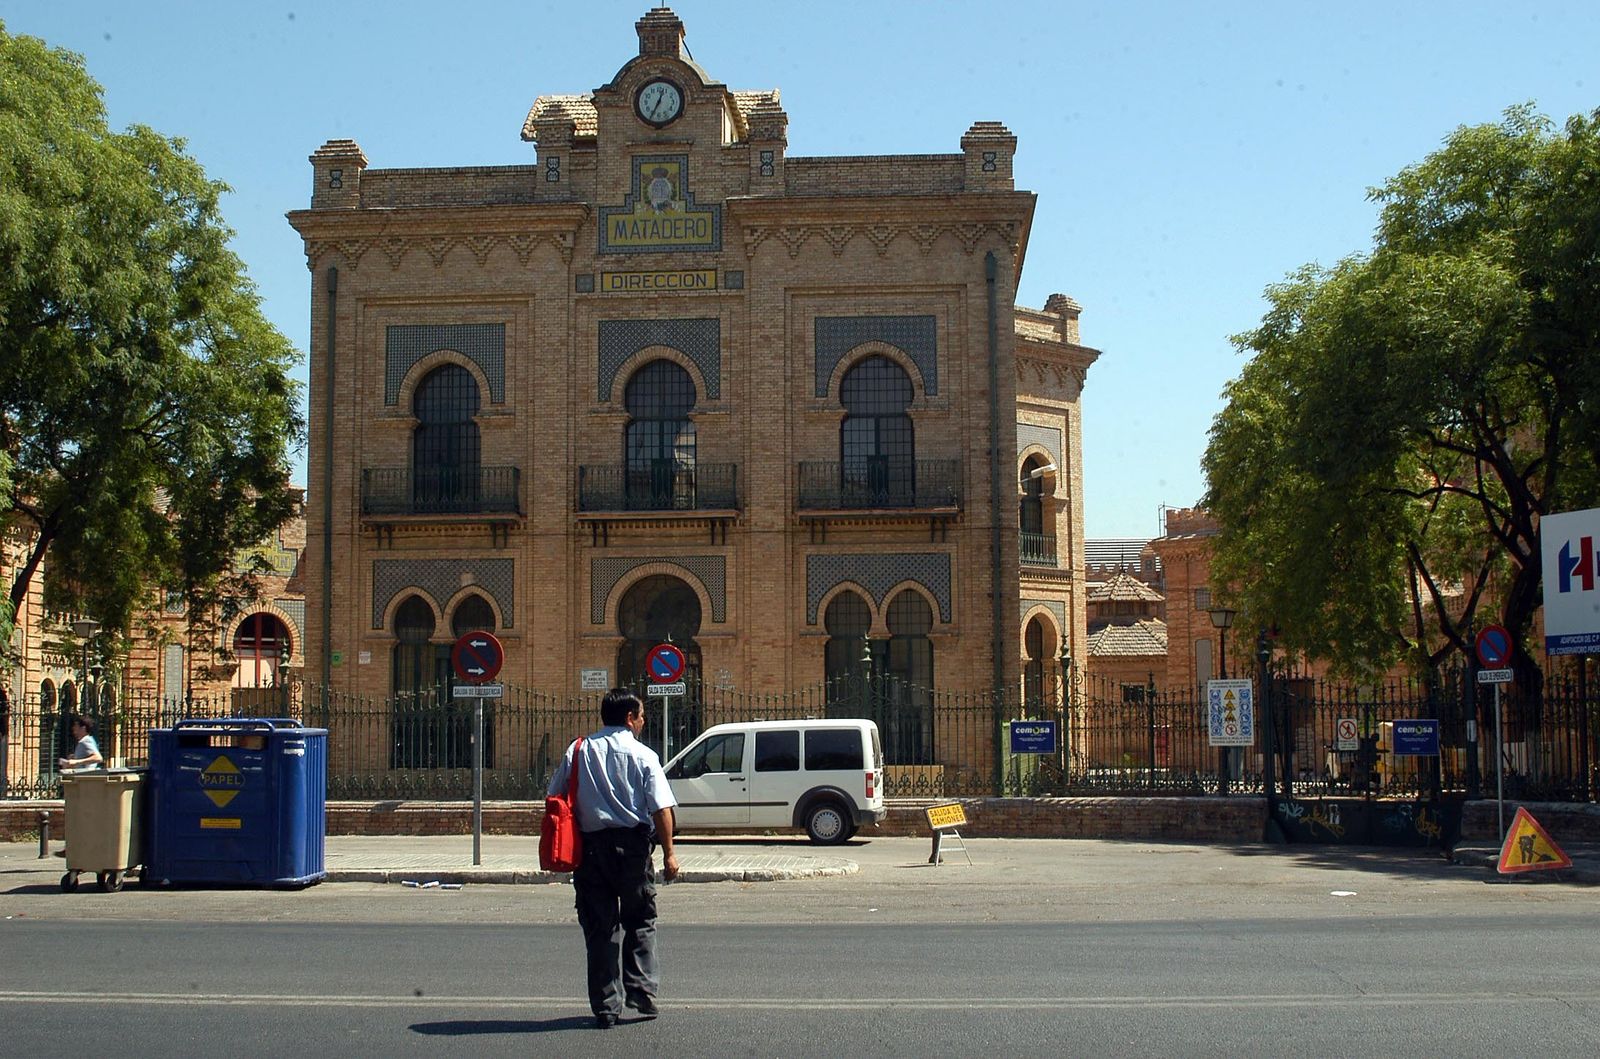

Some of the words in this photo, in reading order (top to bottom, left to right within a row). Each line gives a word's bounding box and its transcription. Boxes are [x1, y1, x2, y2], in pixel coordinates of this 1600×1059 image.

[614, 218, 707, 240] MATADERO
[611, 273, 707, 289] DIRECCION
[204, 775, 241, 785] PAPEL
[929, 808, 951, 817] SALIDA
[952, 806, 961, 814] DE
[932, 814, 964, 825] CAMIONES
